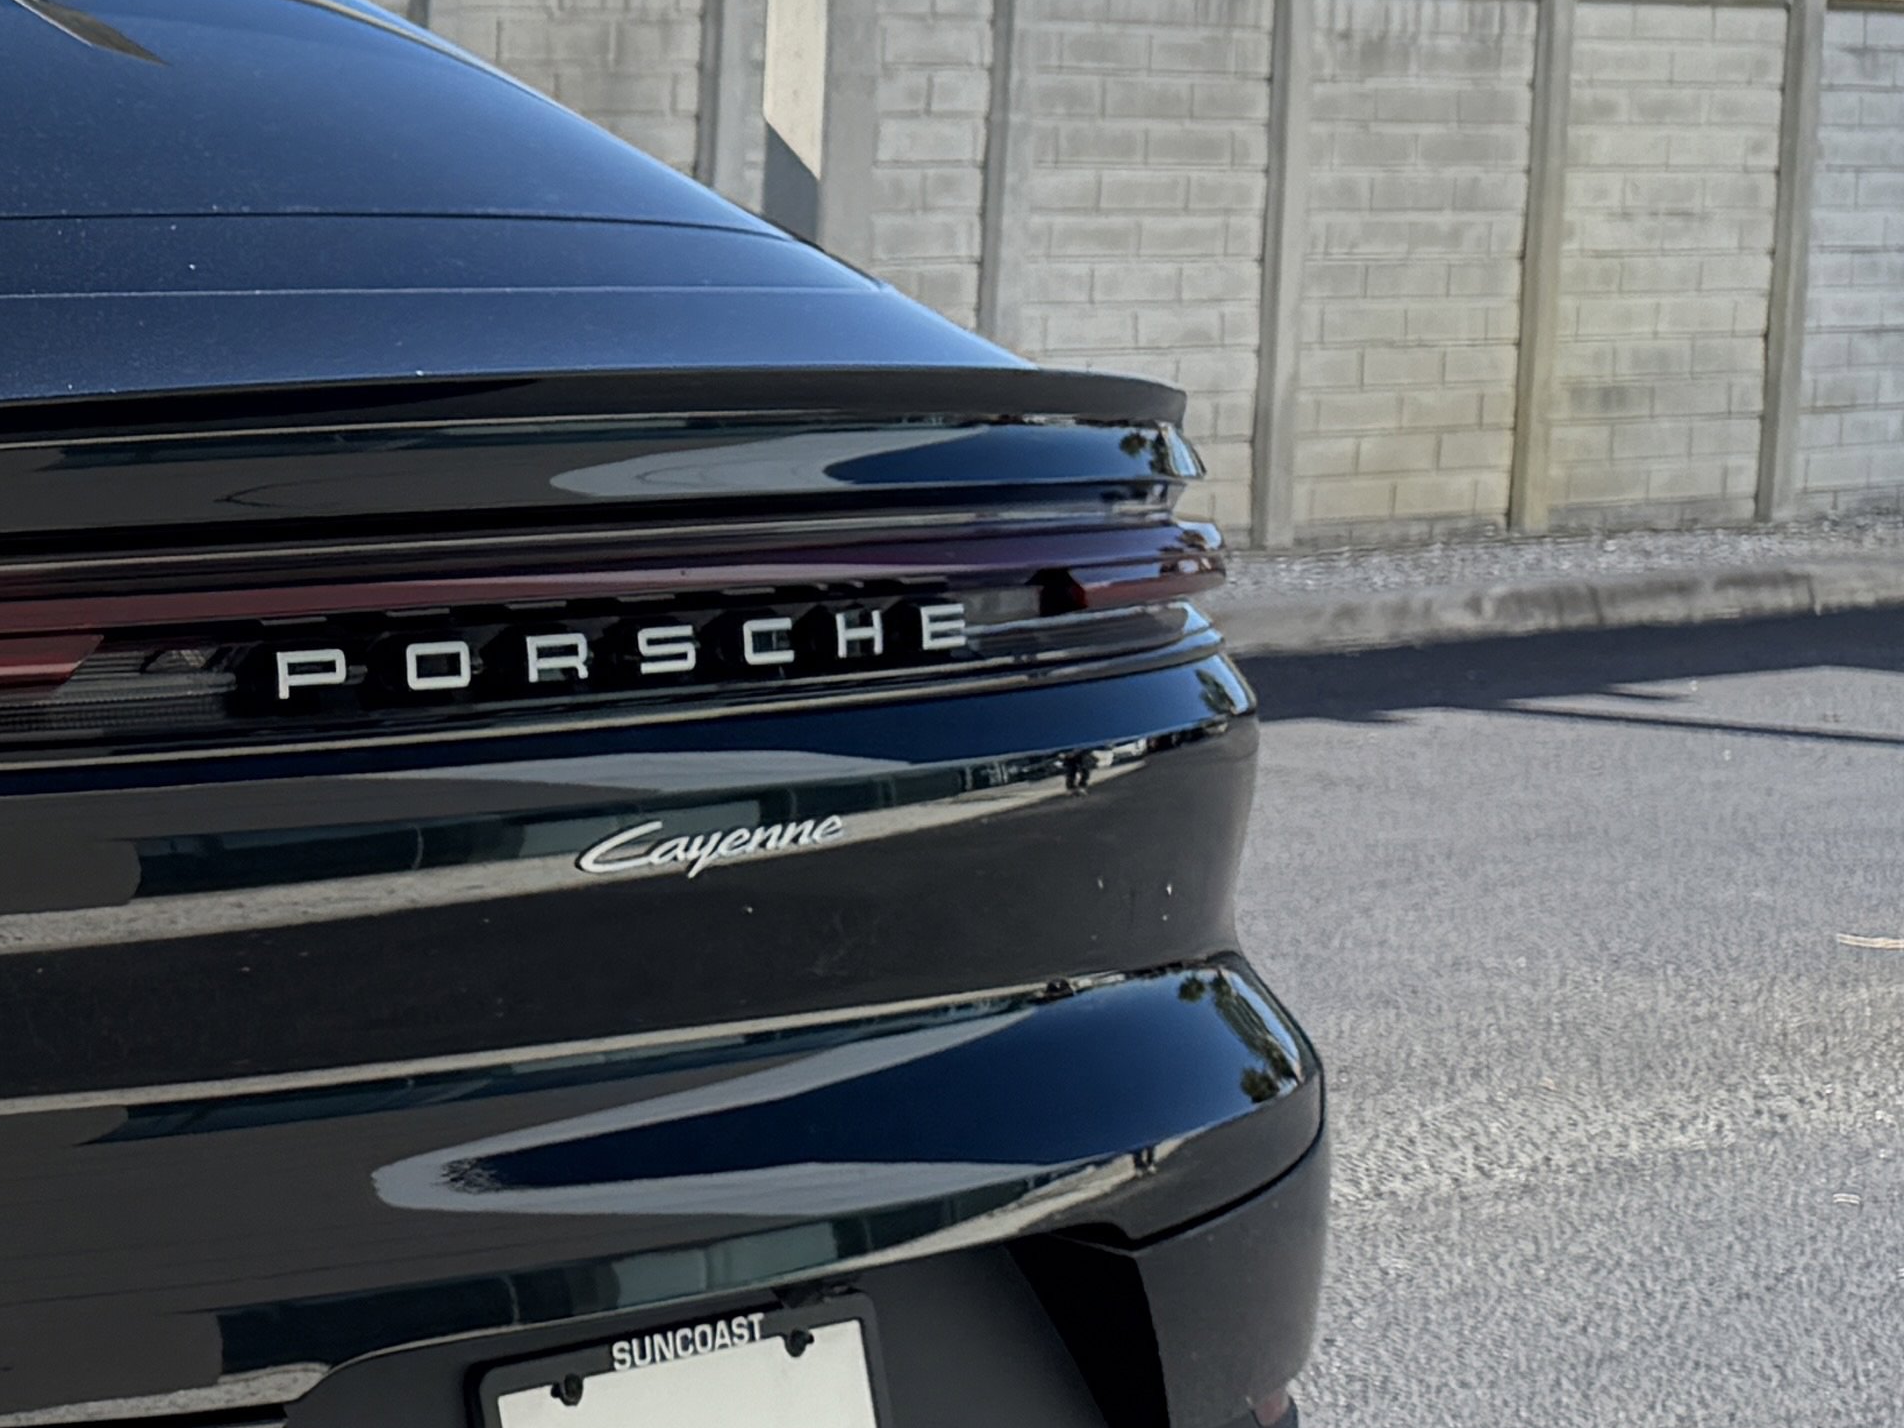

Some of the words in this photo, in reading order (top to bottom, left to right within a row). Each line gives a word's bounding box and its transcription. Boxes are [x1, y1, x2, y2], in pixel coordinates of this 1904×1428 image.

[277, 603, 967, 699] PORSCHE
[578, 814, 843, 878] Cayenne
[612, 1312, 765, 1371] SUNCOAST
